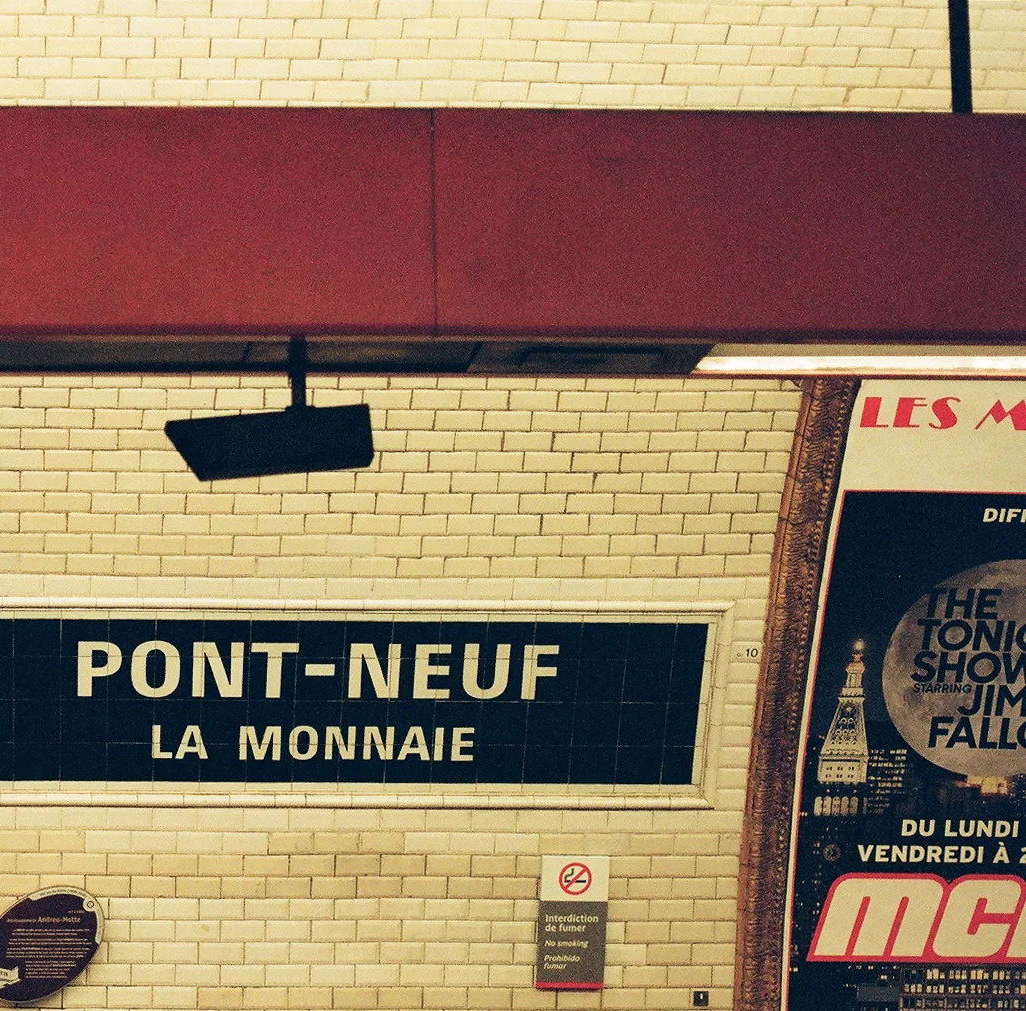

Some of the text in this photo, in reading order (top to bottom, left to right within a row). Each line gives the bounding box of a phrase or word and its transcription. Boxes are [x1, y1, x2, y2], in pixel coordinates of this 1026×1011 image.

[859, 396, 961, 431] LES
[925, 587, 1002, 620] THE
[745, 647, 759, 658] 10
[76, 640, 560, 700] PONT-NEUF
[913, 684, 972, 694] STARRING
[927, 716, 1026, 750] FALL
[151, 724, 475, 762] LA MONNAIE
[901, 819, 1020, 838] DU LUNDI
[857, 844, 984, 864] VENDREDI
[992, 841, 1010, 864] À
[545, 914, 599, 922] Interdiction
[545, 923, 586, 932] de fumer
[557, 940, 589, 949] smoking
[544, 954, 581, 962] Prohibido
[544, 962, 567, 970] fumar
